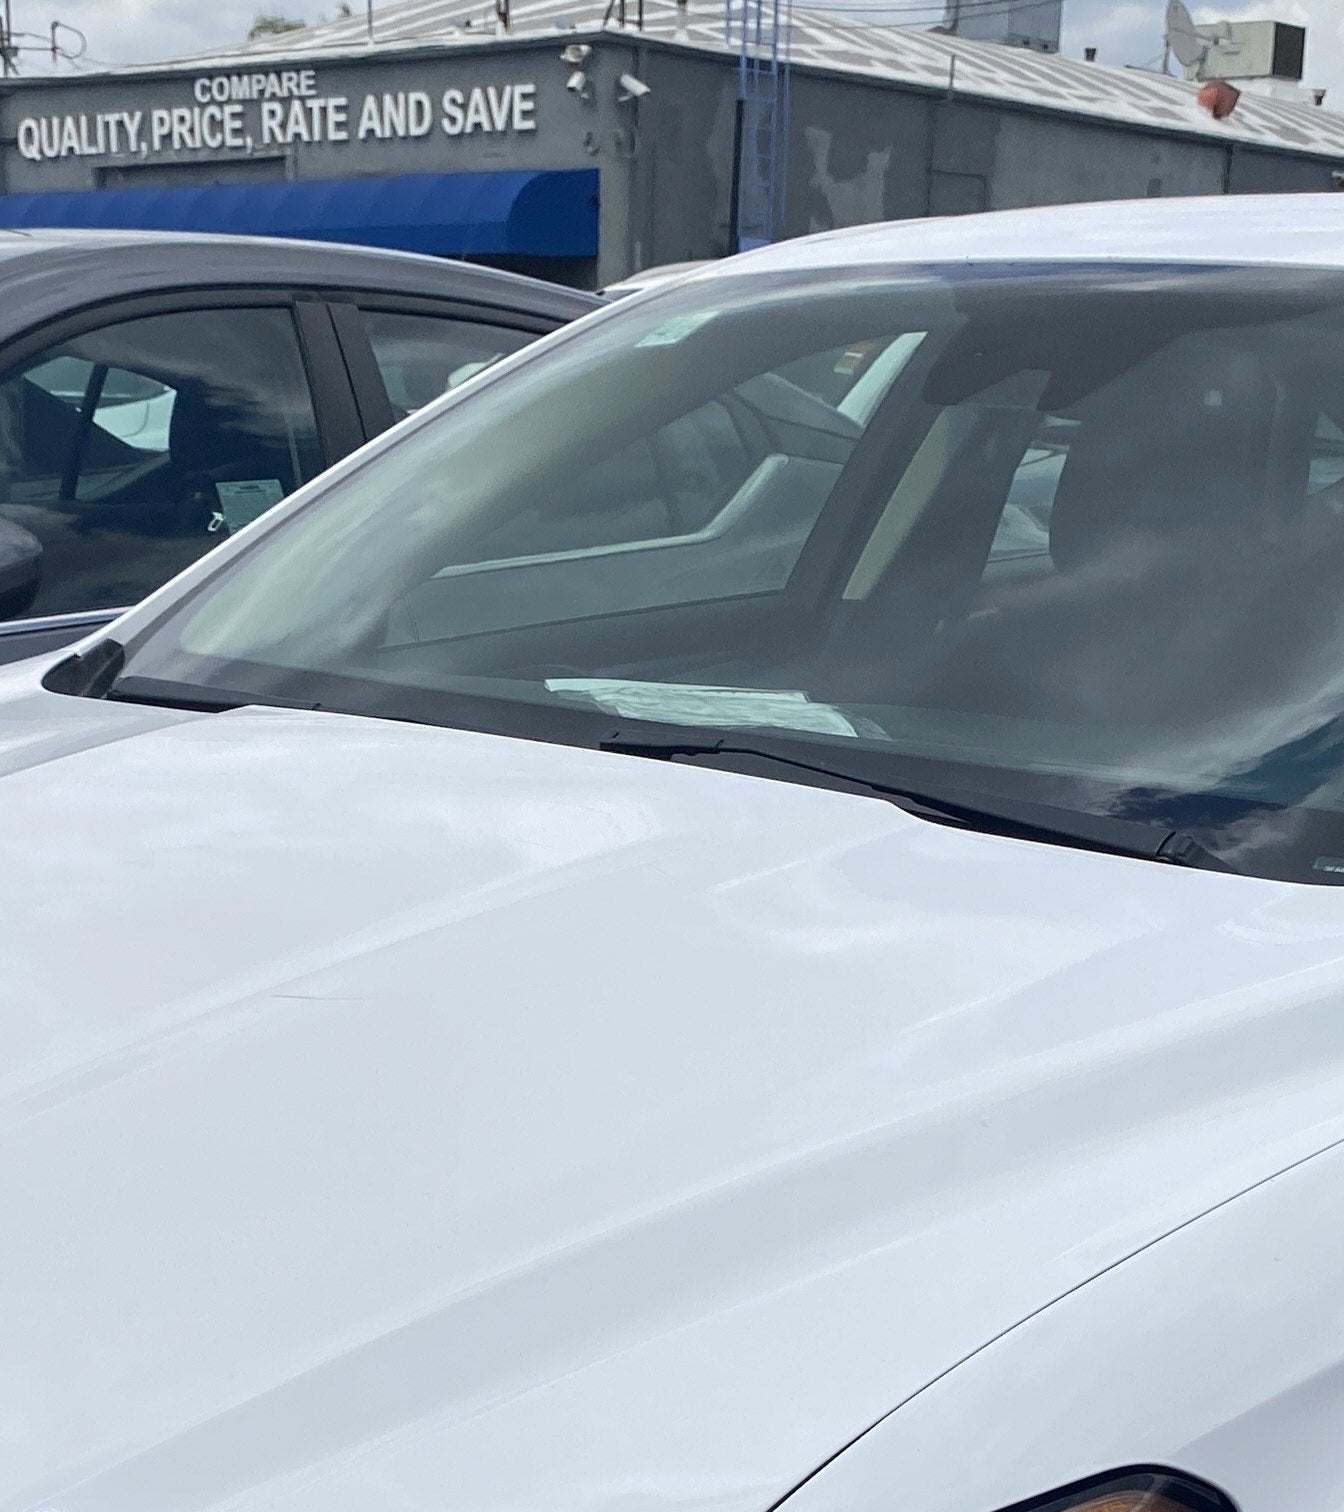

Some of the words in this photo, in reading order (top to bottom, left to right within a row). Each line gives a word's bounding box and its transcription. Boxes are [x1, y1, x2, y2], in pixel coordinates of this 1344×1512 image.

[194, 70, 317, 103] COMPARE
[17, 111, 148, 161] QUALITY,
[152, 104, 253, 154] PRICE,
[261, 97, 348, 144] RATE
[358, 92, 432, 139] AND
[441, 84, 536, 135] SAVE
